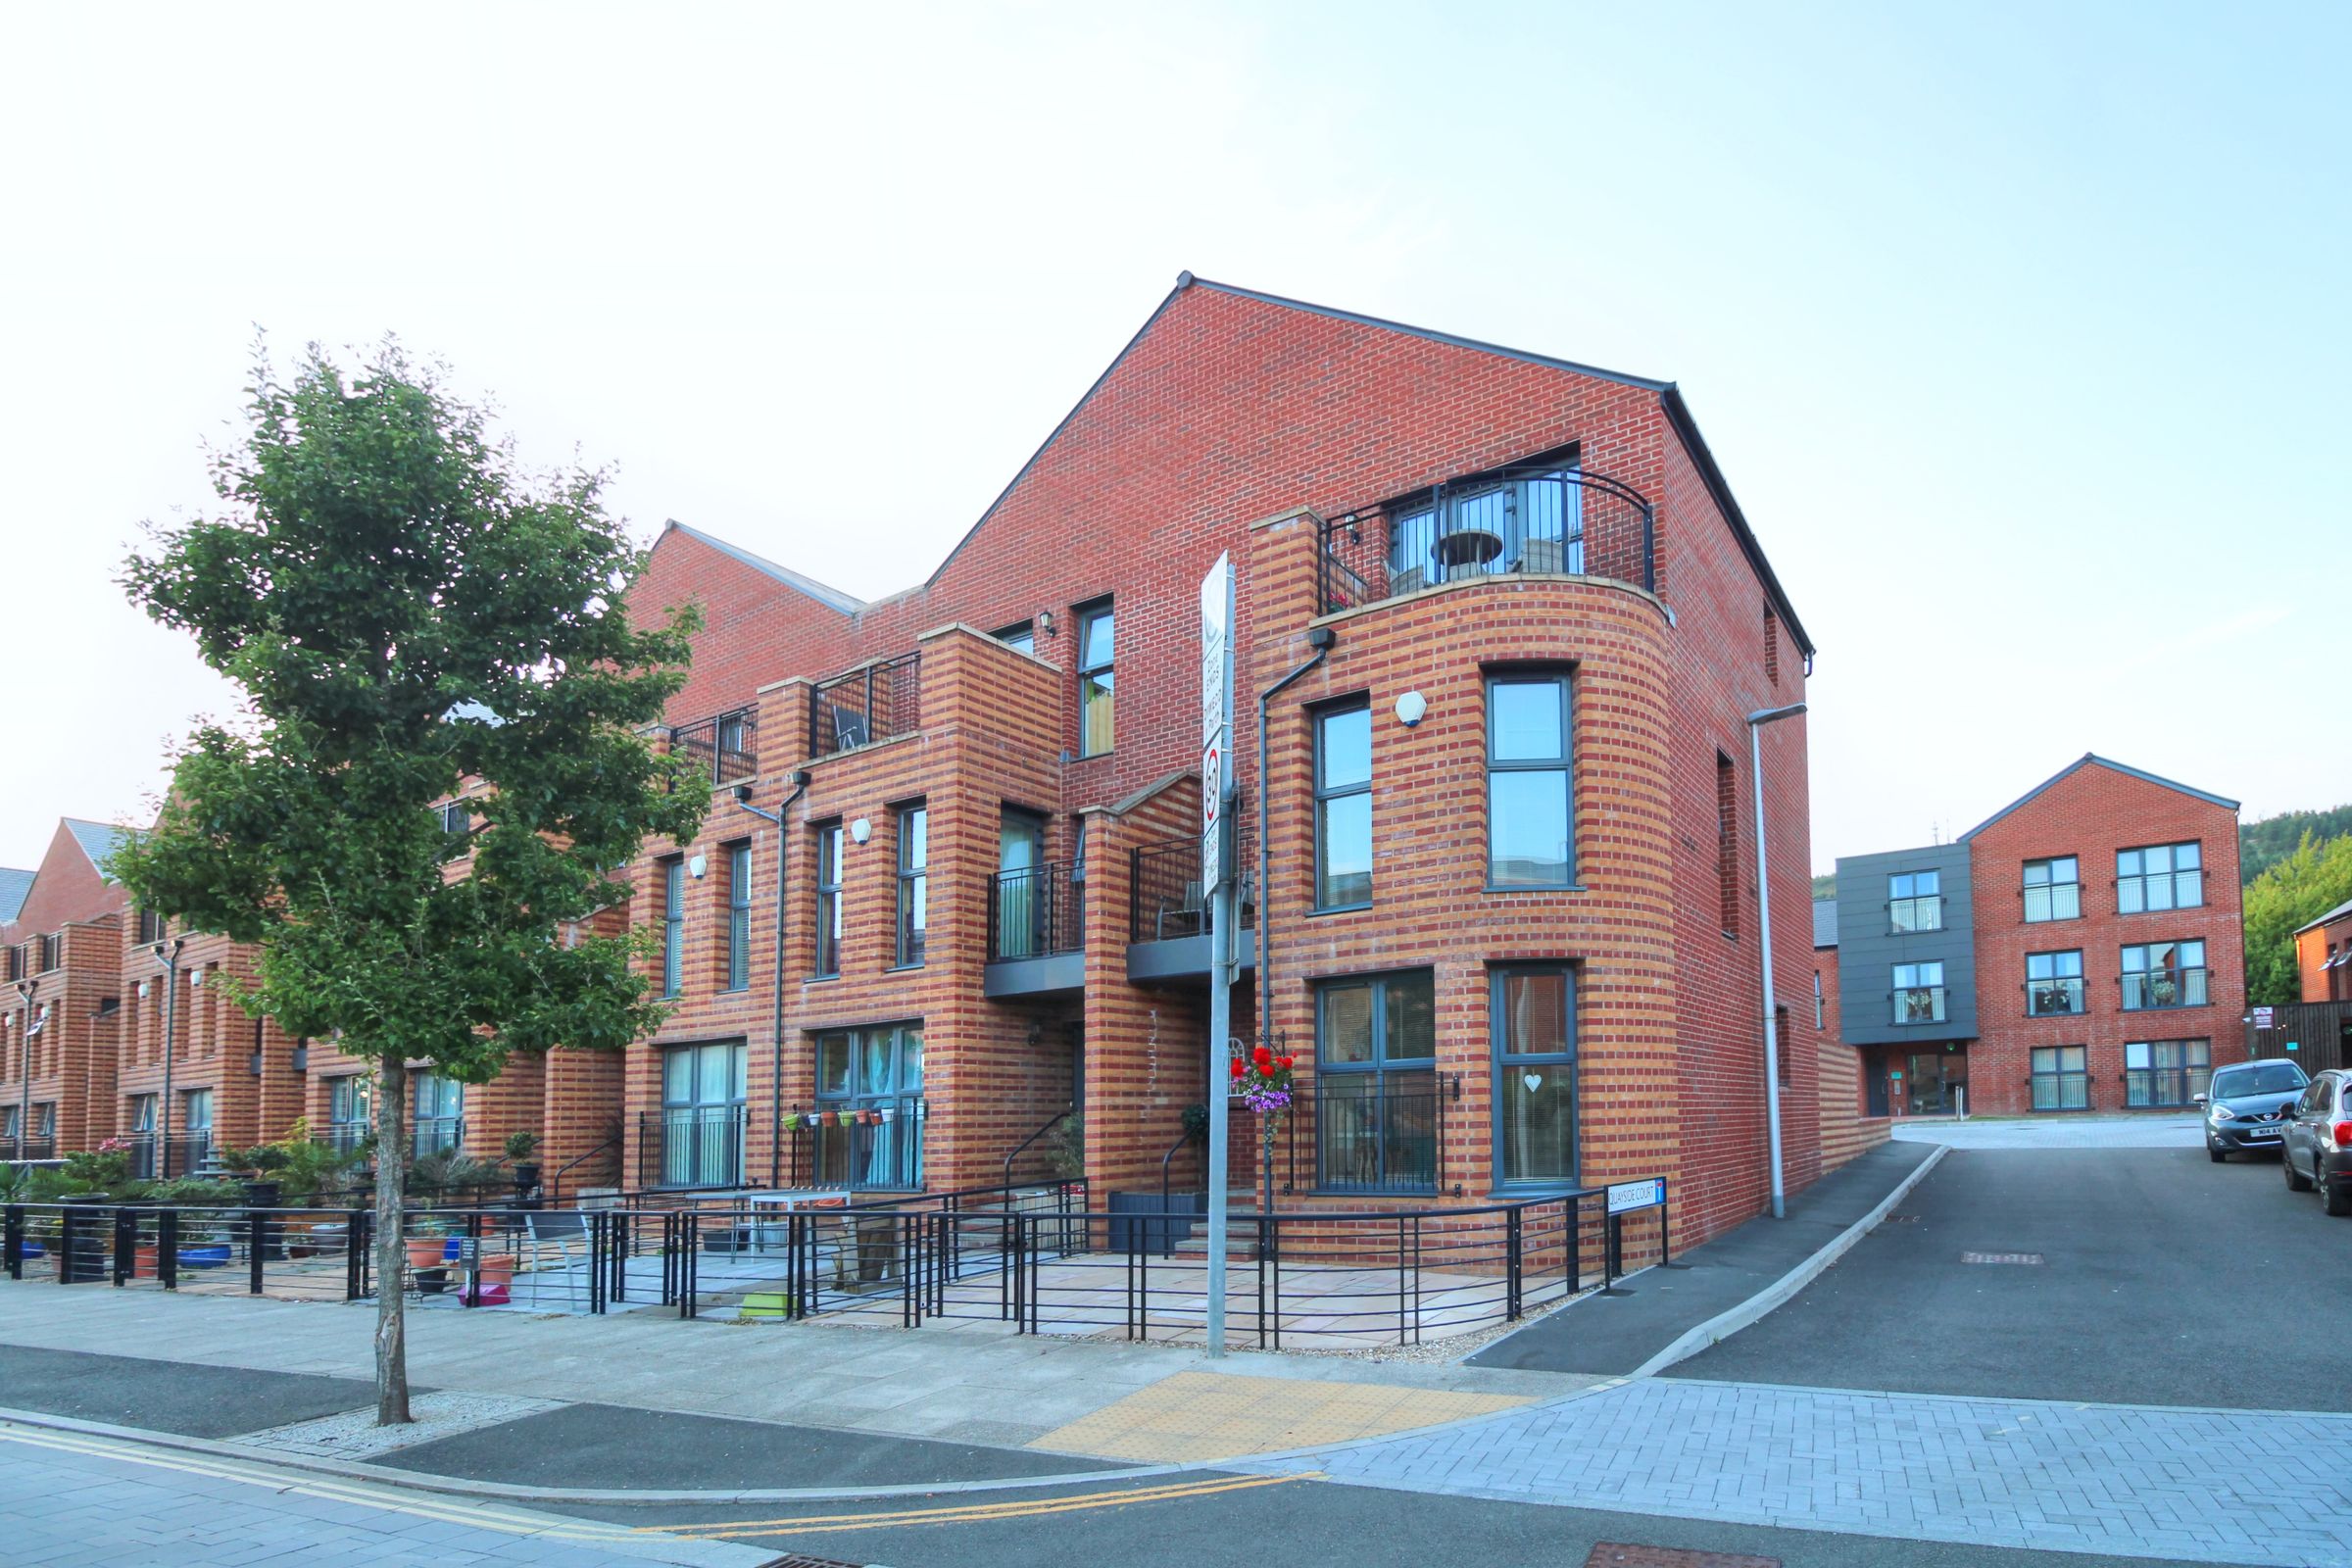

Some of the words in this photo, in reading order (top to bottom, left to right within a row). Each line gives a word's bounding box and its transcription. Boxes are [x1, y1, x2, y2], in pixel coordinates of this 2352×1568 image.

[1207, 767, 1217, 804] 30
[1608, 1189, 1635, 1205] QUAYSIDE
[1637, 1186, 1654, 1200] COURT
